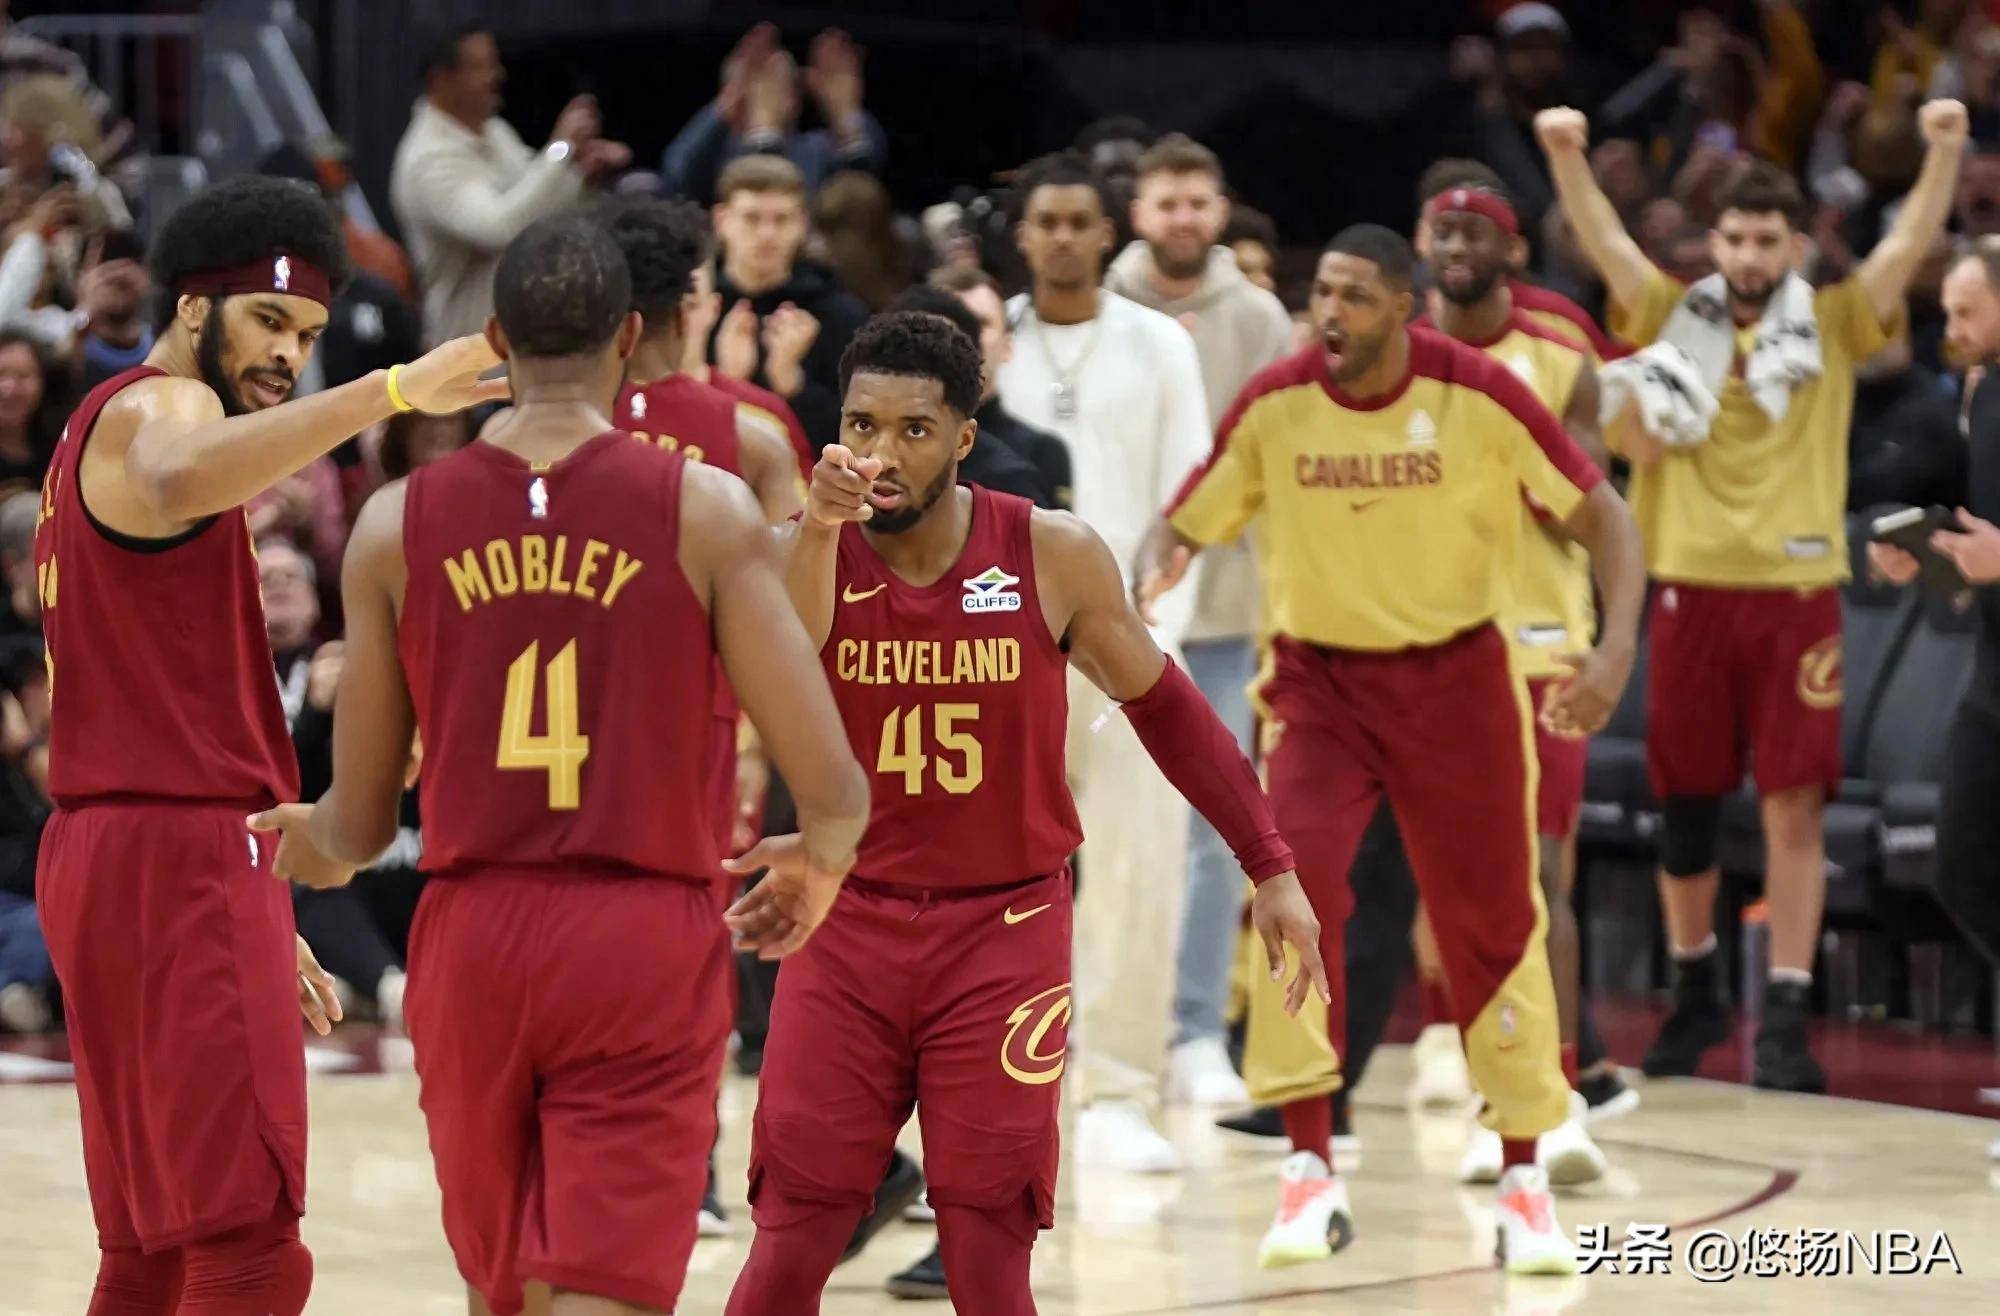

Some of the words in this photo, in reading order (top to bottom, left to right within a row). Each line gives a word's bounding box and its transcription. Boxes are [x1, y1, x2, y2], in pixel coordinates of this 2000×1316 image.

[1295, 451, 1442, 488] CAVALIERS
[443, 534, 643, 612] MOBLEY
[964, 595, 1018, 609] CLIFFS
[836, 637, 1021, 685] CLEVELAND
[496, 636, 590, 809] 4
[876, 702, 983, 795] 45
